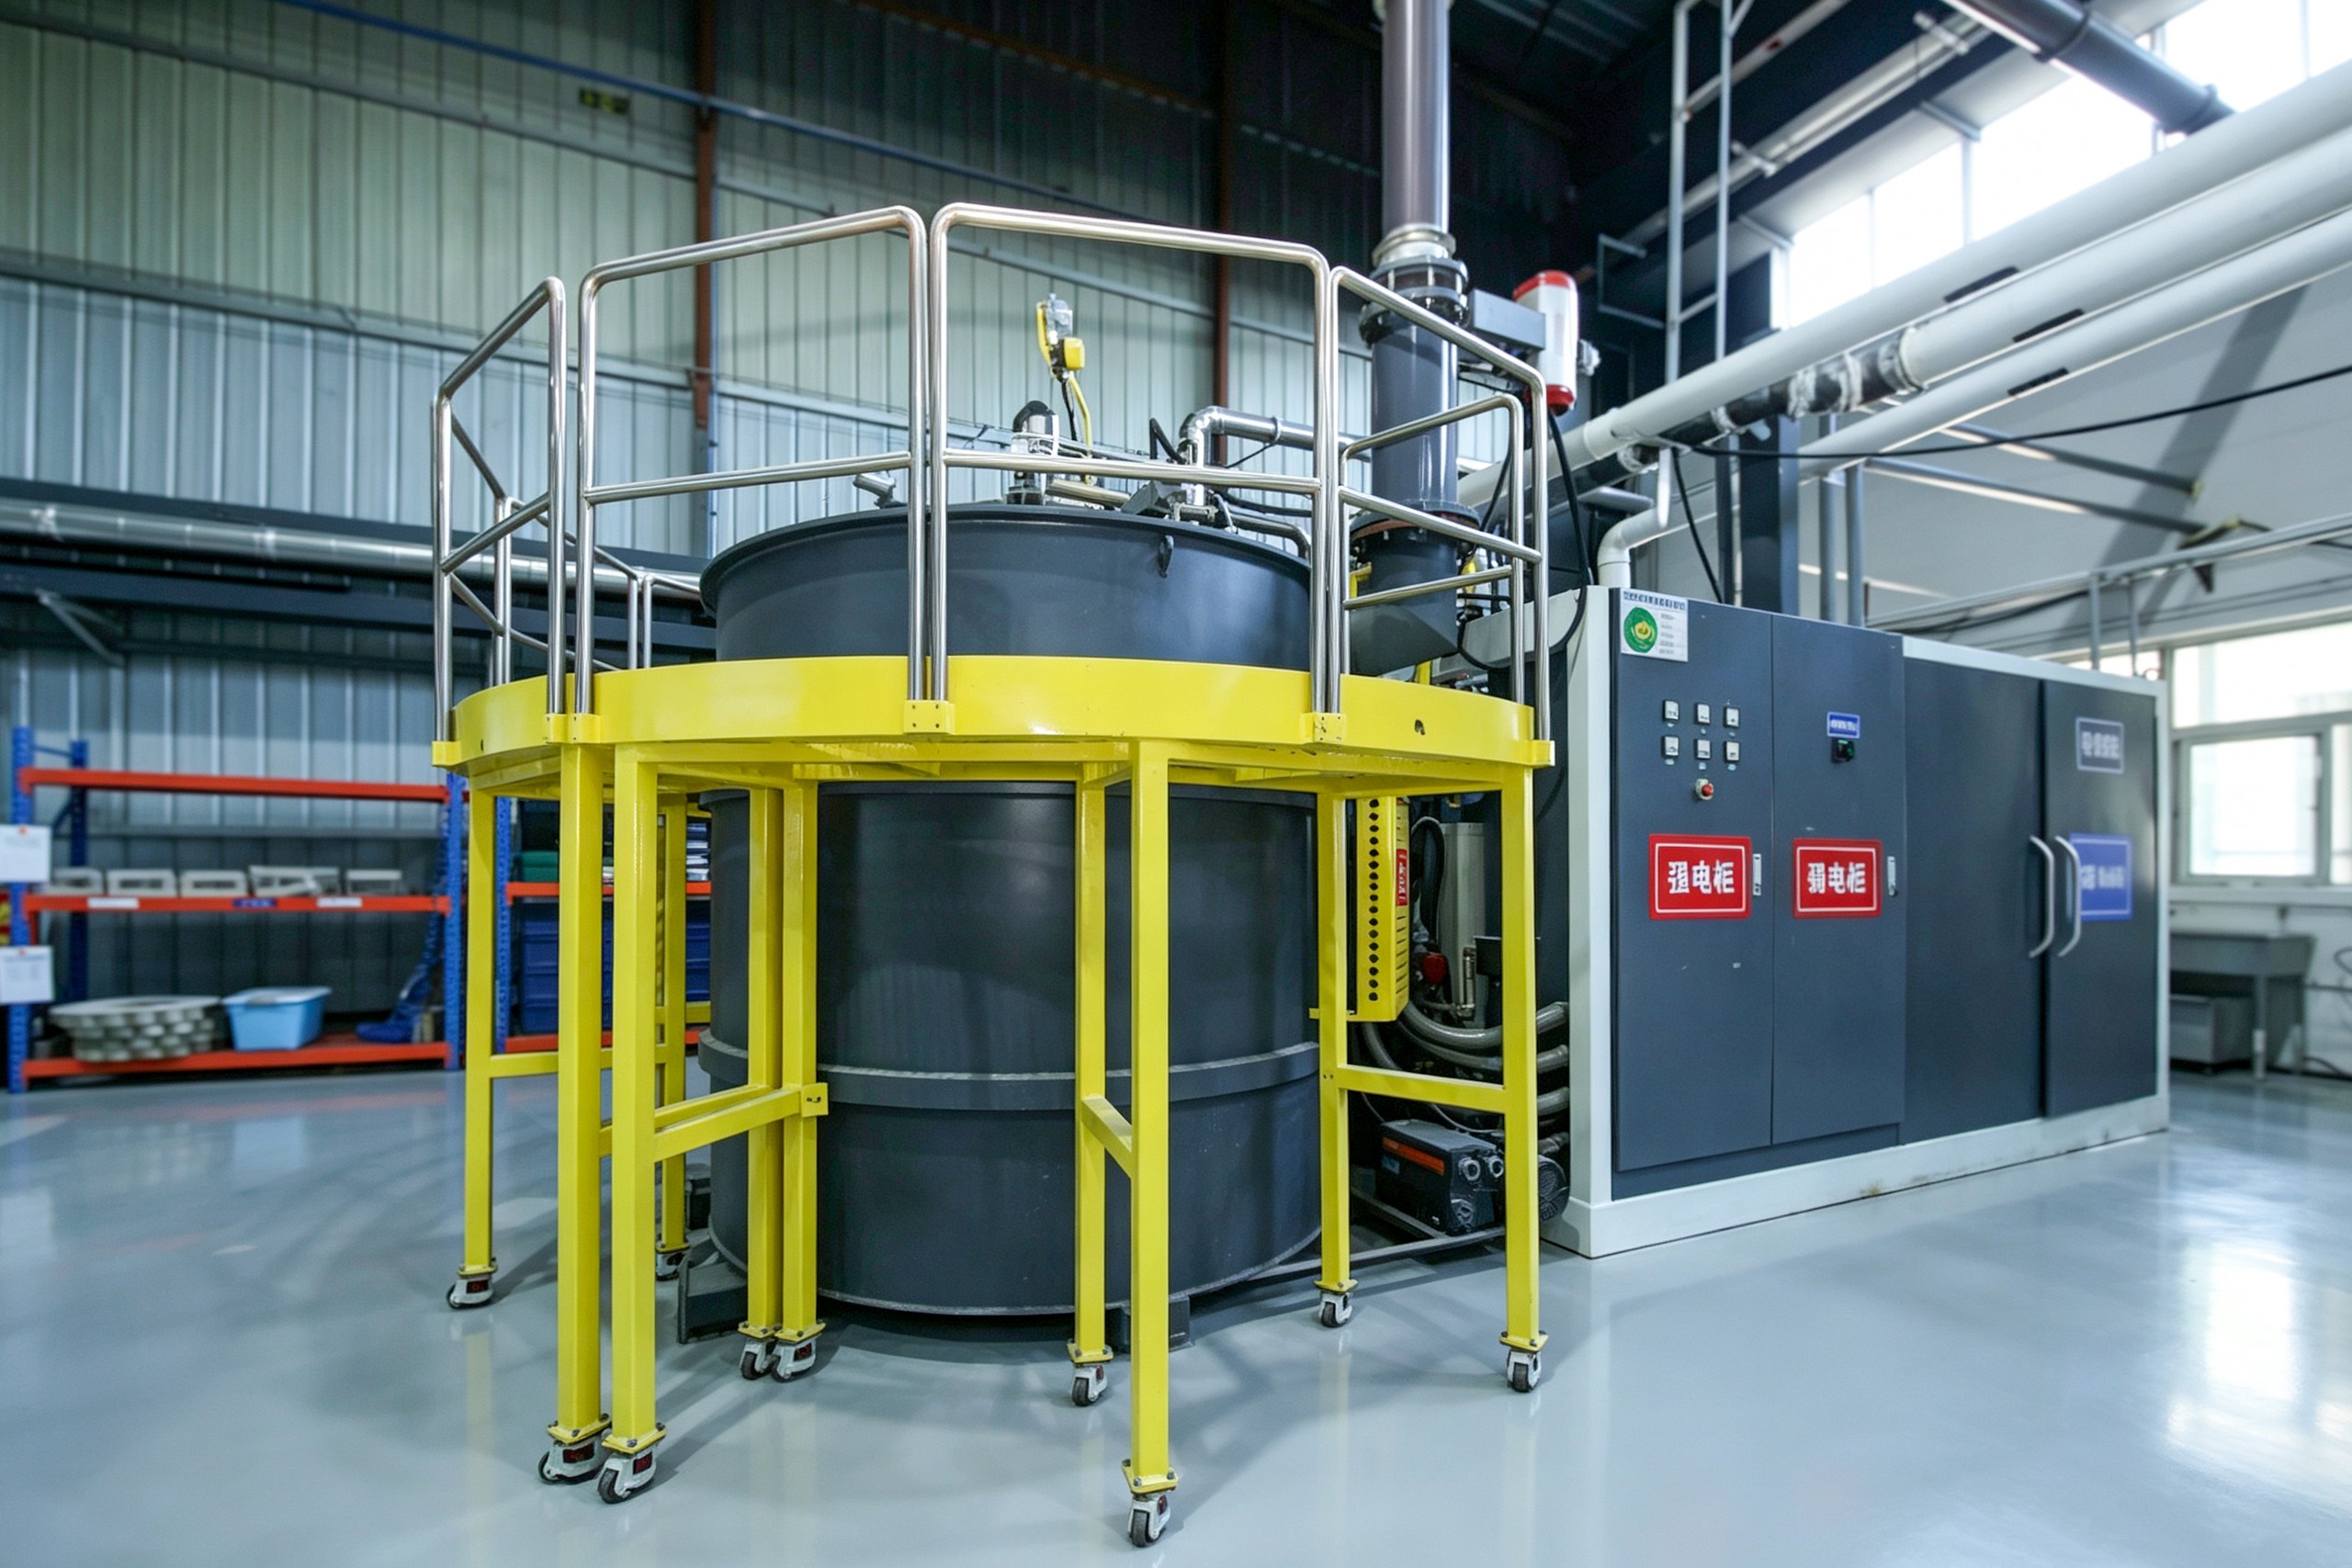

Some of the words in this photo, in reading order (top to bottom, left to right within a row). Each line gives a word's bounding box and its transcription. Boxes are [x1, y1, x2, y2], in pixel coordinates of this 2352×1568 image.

[1668, 860, 1735, 894] 强电柜
[1807, 862, 1866, 894] 弱电柜
